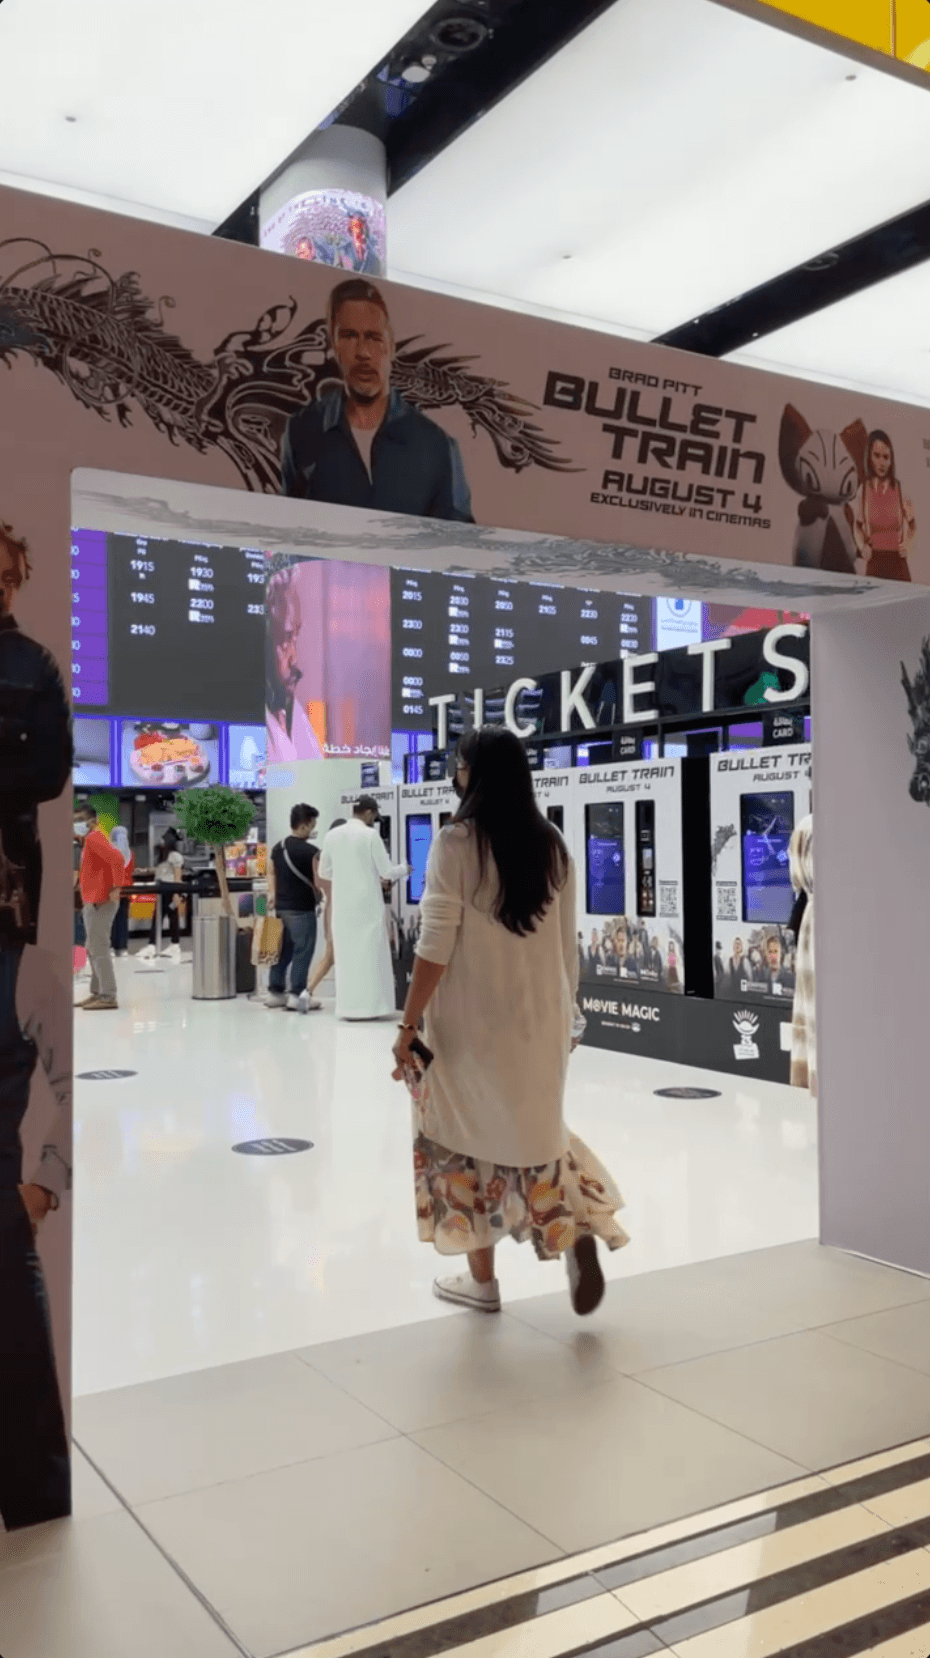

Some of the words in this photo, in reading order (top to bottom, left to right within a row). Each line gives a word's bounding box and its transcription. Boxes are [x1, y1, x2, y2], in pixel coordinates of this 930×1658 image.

[609, 367, 659, 388] BRAD
[662, 378, 702, 396] PITT
[543, 370, 756, 444] BULLET
[602, 422, 766, 484] TRAIN
[601, 470, 735, 508] AUGUST
[742, 493, 762, 514] 4
[590, 492, 686, 516] EXCLUSIVELY
[706, 509, 771, 530] CINEMAS
[428, 624, 809, 750] TICKETS
[579, 770, 628, 784] BULLET
[630, 766, 675, 779] TRAIN
[718, 755, 783, 771] BULLET
[534, 776, 568, 788] TRAIN
[606, 784, 640, 793] AUGUST
[753, 770, 800, 782] AUGUST
[402, 788, 434, 798] BULLET
[583, 997, 618, 1015] MOVIE
[621, 1002, 660, 1022] MAGIC
